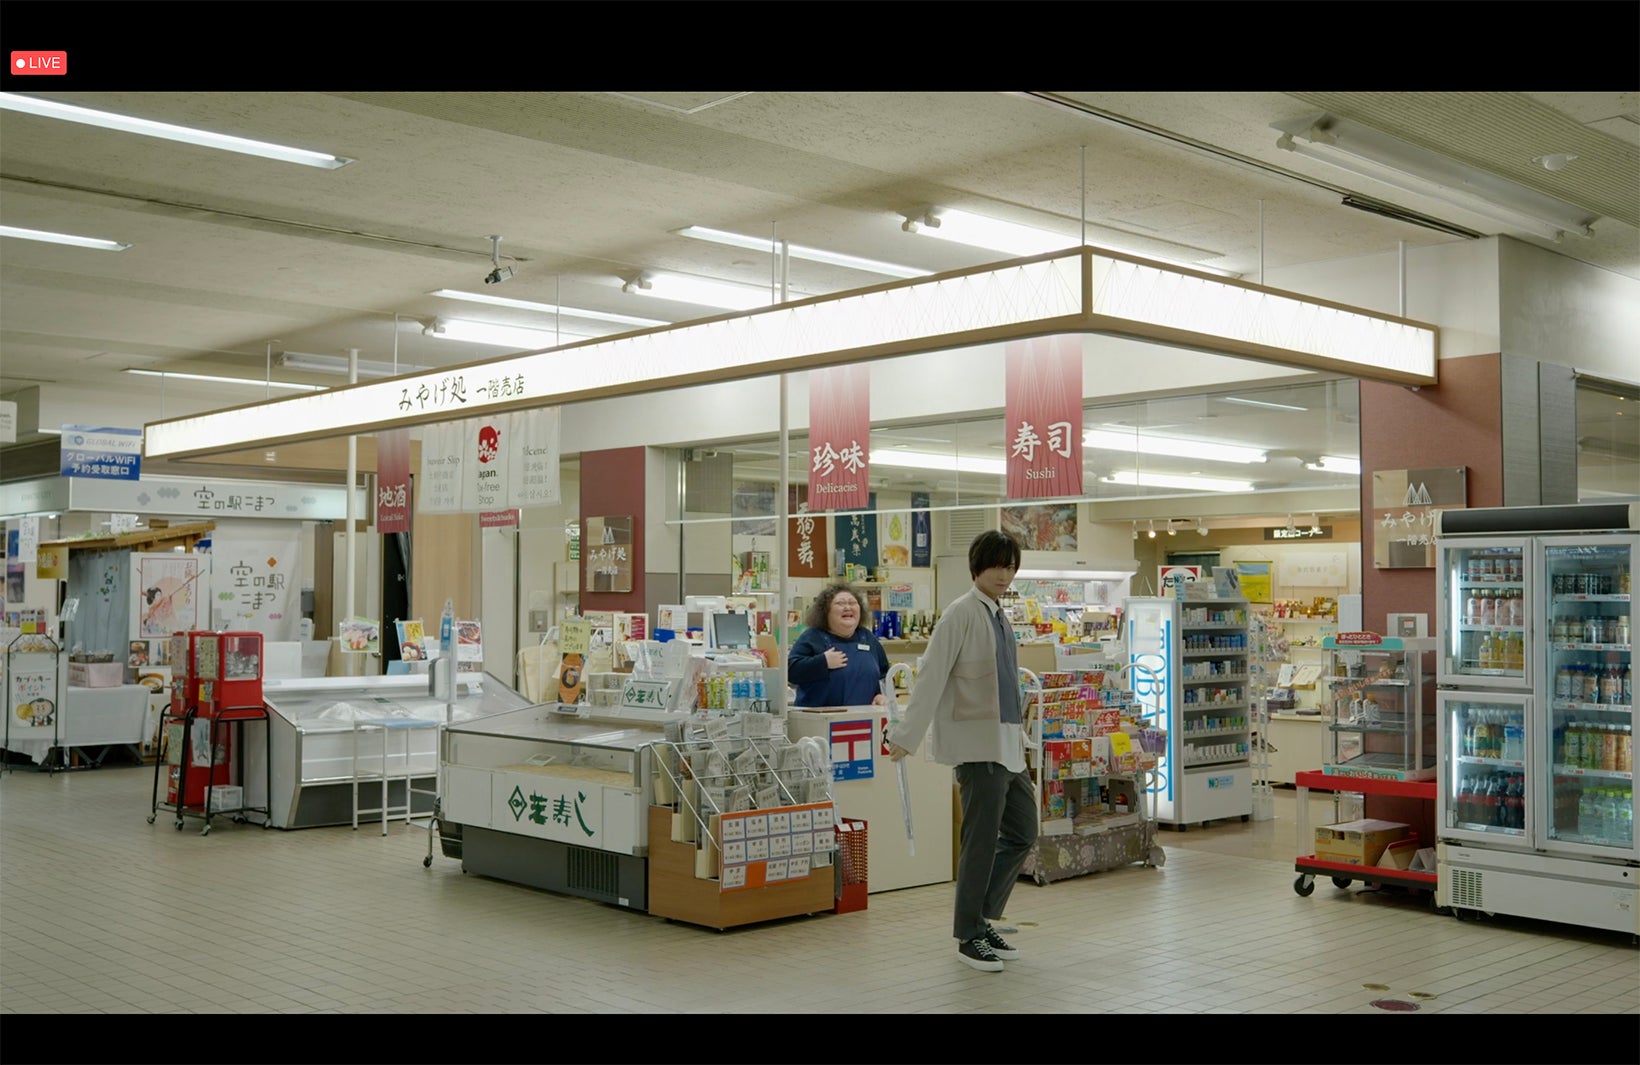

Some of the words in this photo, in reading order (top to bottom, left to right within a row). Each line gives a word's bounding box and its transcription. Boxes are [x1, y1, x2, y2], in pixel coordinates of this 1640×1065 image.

[399, 376, 466, 411] みやげ処
[476, 373, 524, 399] 一階売店
[1011, 421, 1072, 462] 寿司
[71, 463, 130, 475] 予約受取窓口
[812, 440, 866, 477] 珍味
[1026, 467, 1055, 480] Sushi
[193, 485, 275, 511] 空の駅こまつ
[379, 484, 406, 507] 地酒
[816, 482, 858, 494] Delicacies
[590, 547, 626, 561] みやげ処
[230, 560, 285, 590] 空の駅
